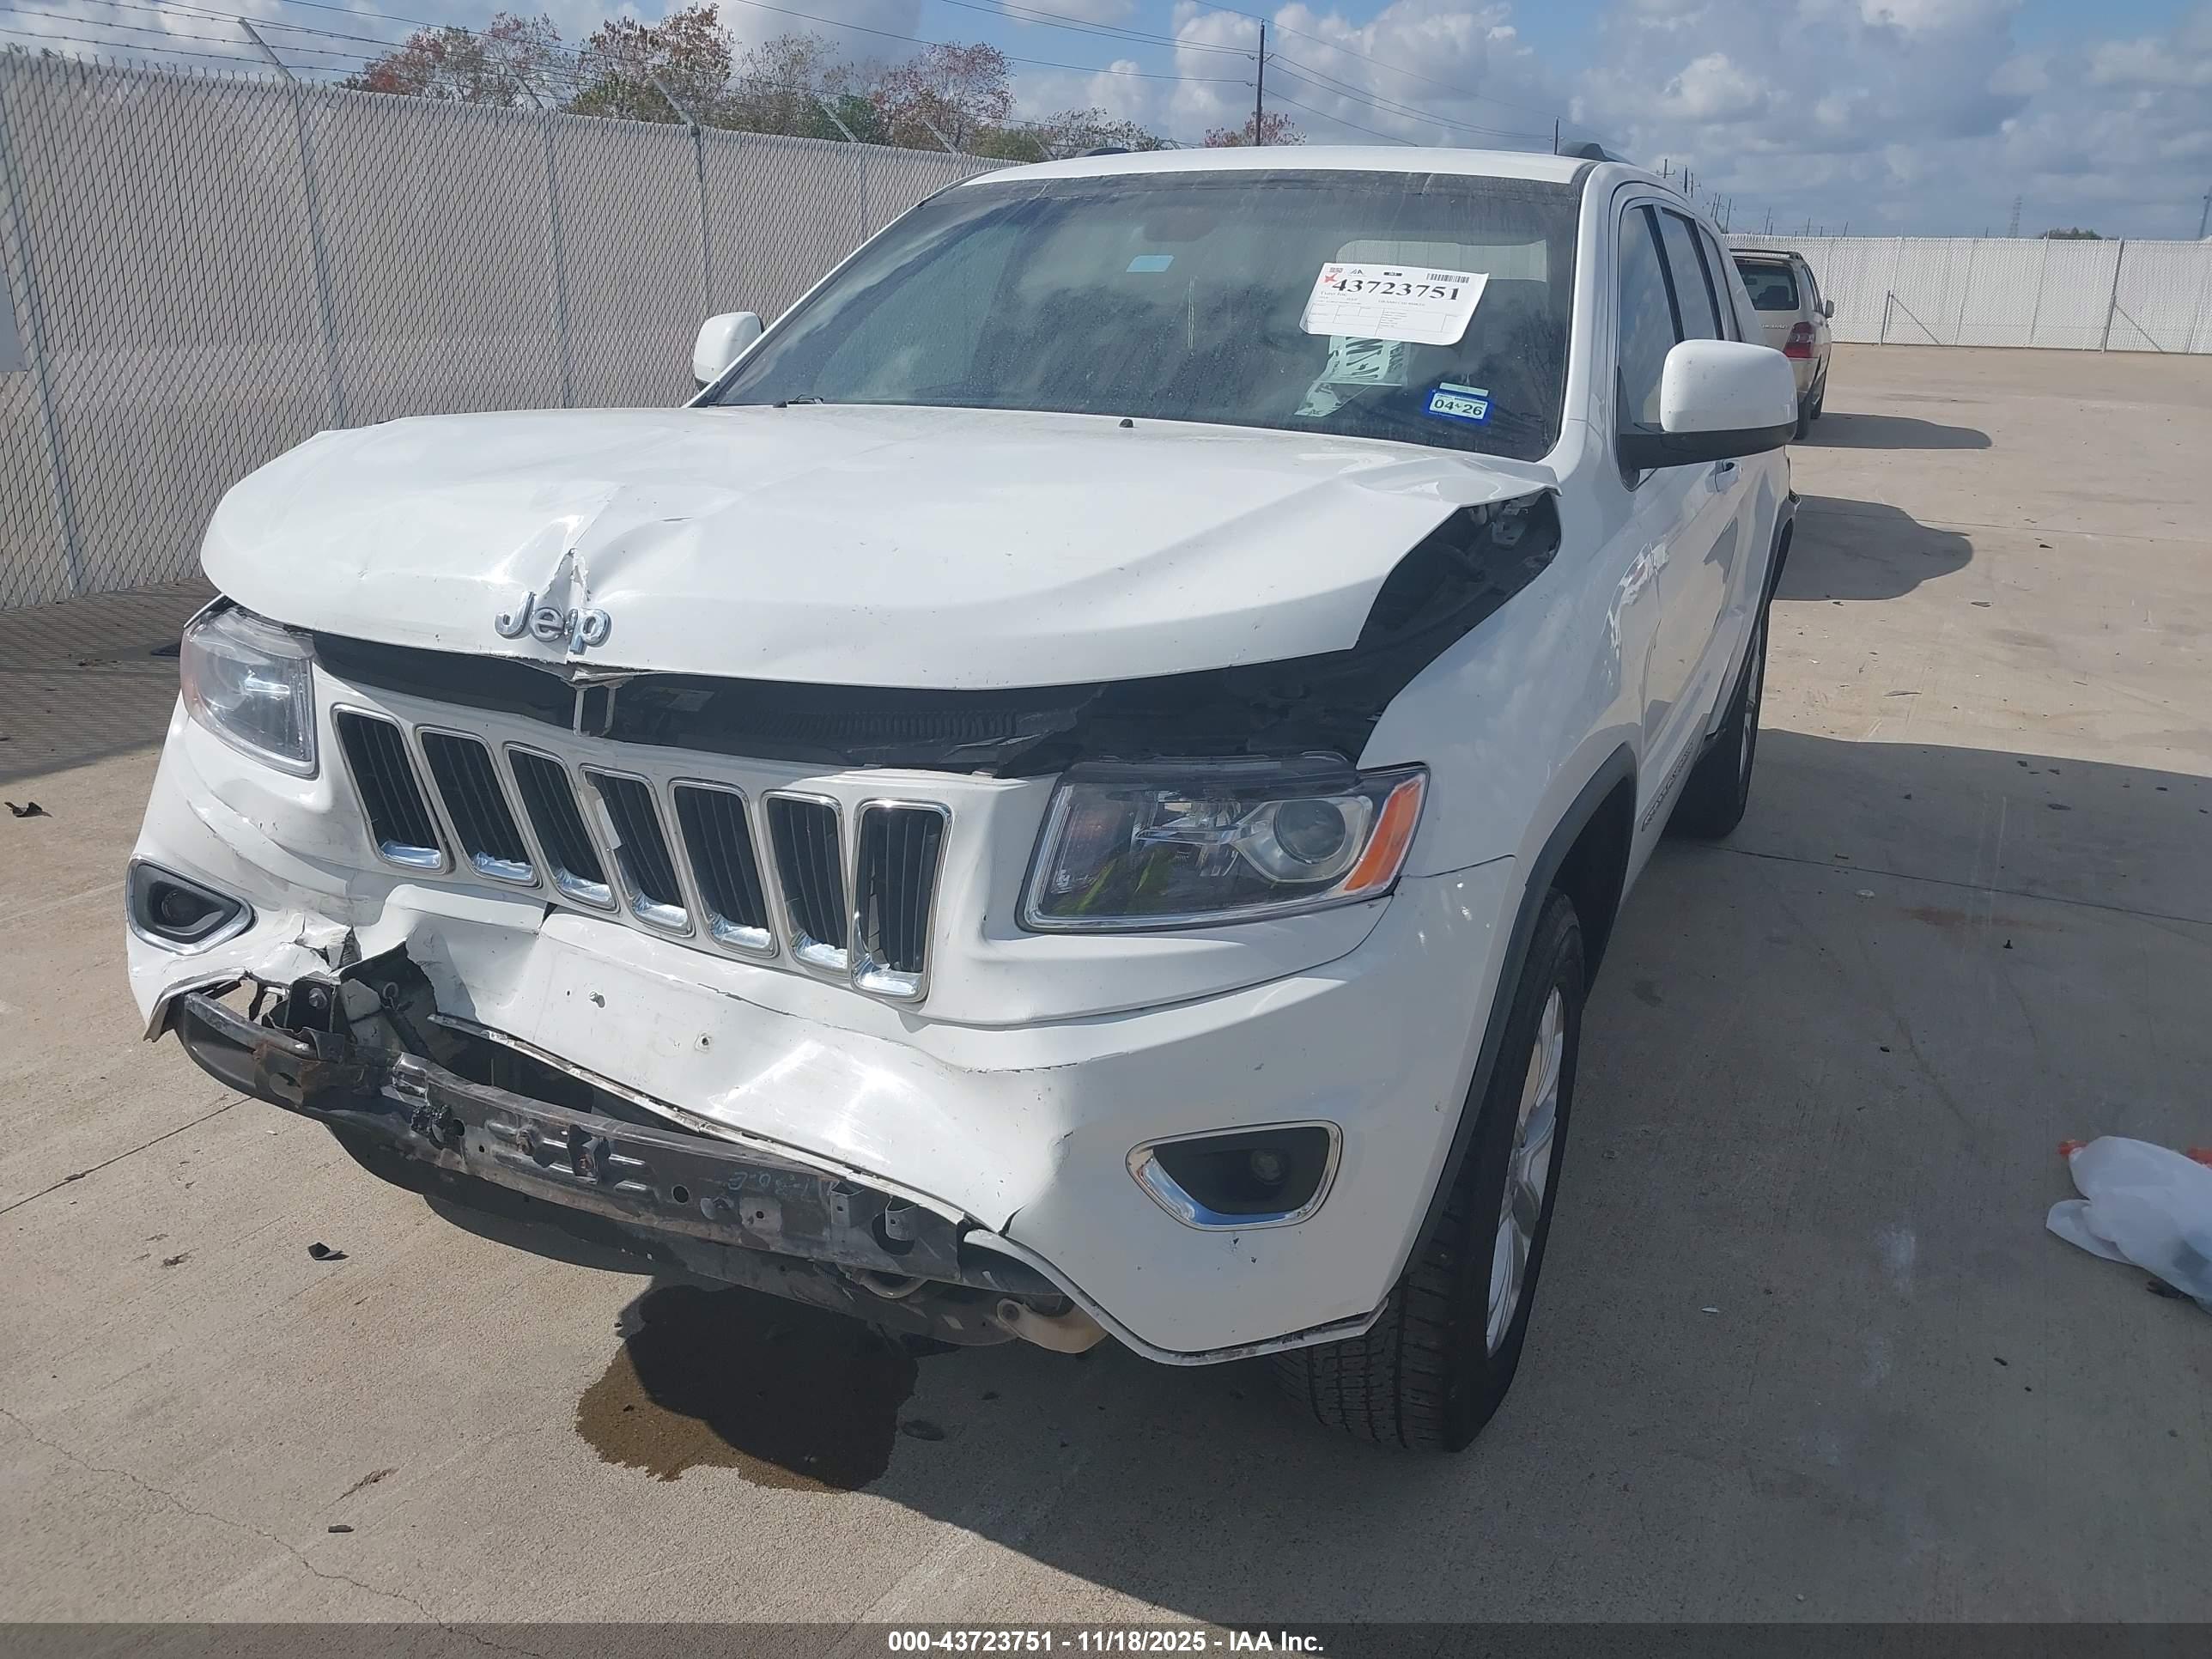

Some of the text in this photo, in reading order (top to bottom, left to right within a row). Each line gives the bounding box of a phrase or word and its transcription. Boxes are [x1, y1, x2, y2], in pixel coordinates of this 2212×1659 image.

[1332, 278, 1460, 301] 43723751
[1434, 398, 1455, 410] 04
[1462, 404, 1484, 416] 26
